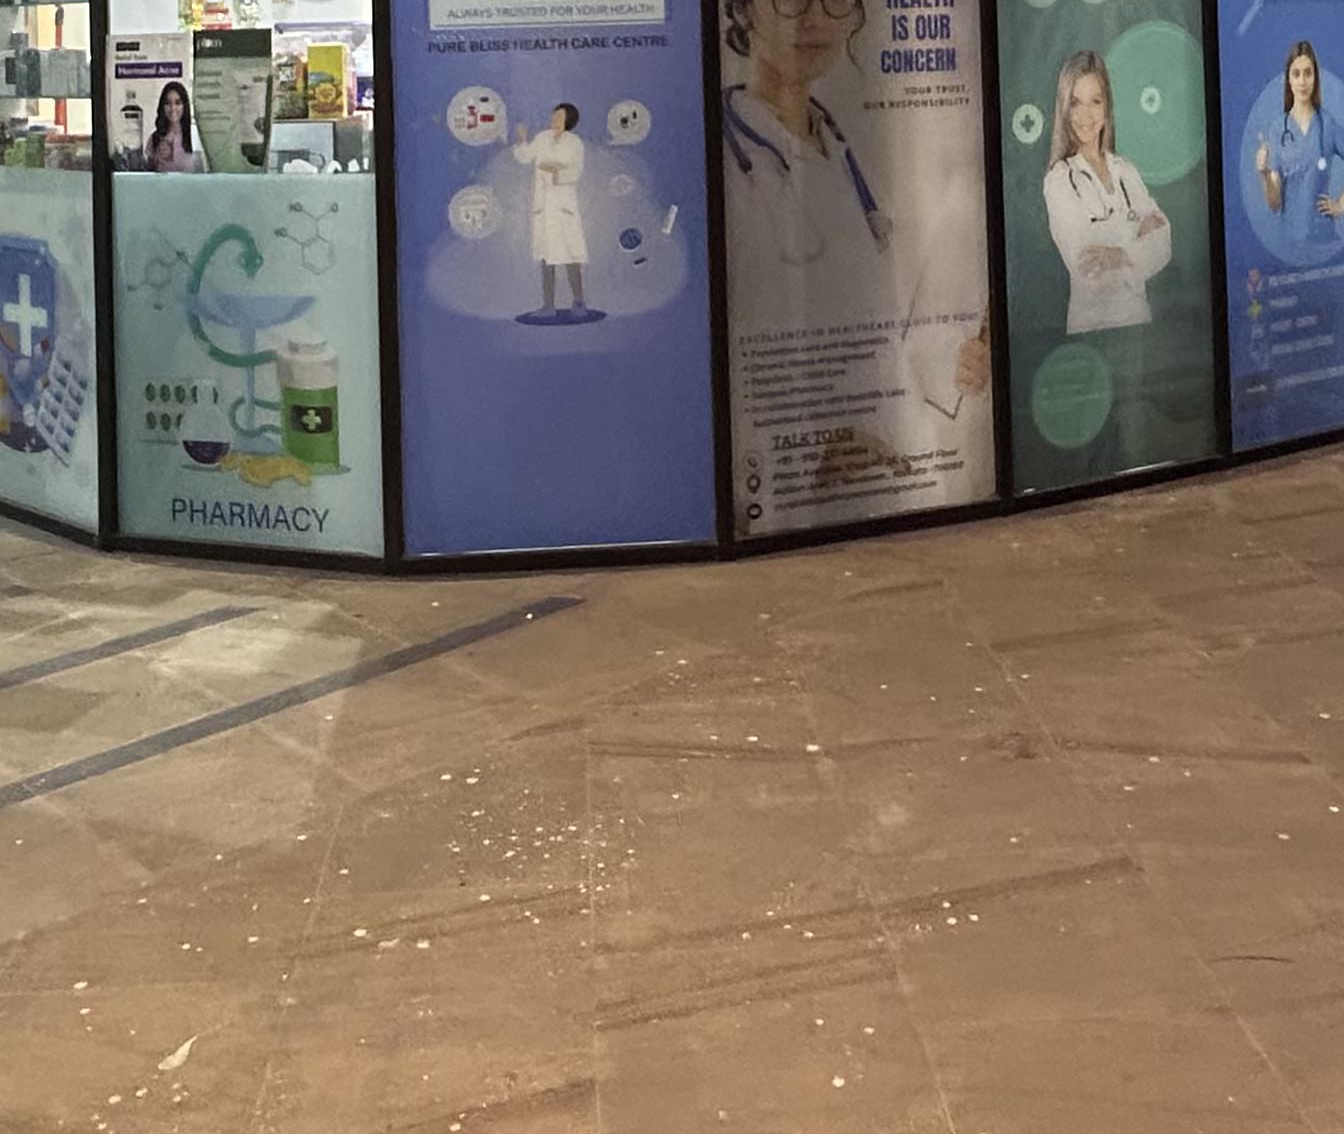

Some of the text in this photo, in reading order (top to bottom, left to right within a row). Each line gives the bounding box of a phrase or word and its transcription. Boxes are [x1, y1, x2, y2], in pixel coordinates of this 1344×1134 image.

[447, 7, 493, 20] ALWAYS
[550, 4, 574, 17] FOR
[576, 3, 608, 16] YOUR
[610, 2, 655, 15] HEALTH
[892, 15, 951, 41] IS OUR
[428, 35, 670, 54] PURE BLISS HEALTH CARE CENTRE
[881, 48, 956, 74] CONCERN
[772, 433, 809, 450] TALK
[171, 498, 330, 533] PHARMACY
